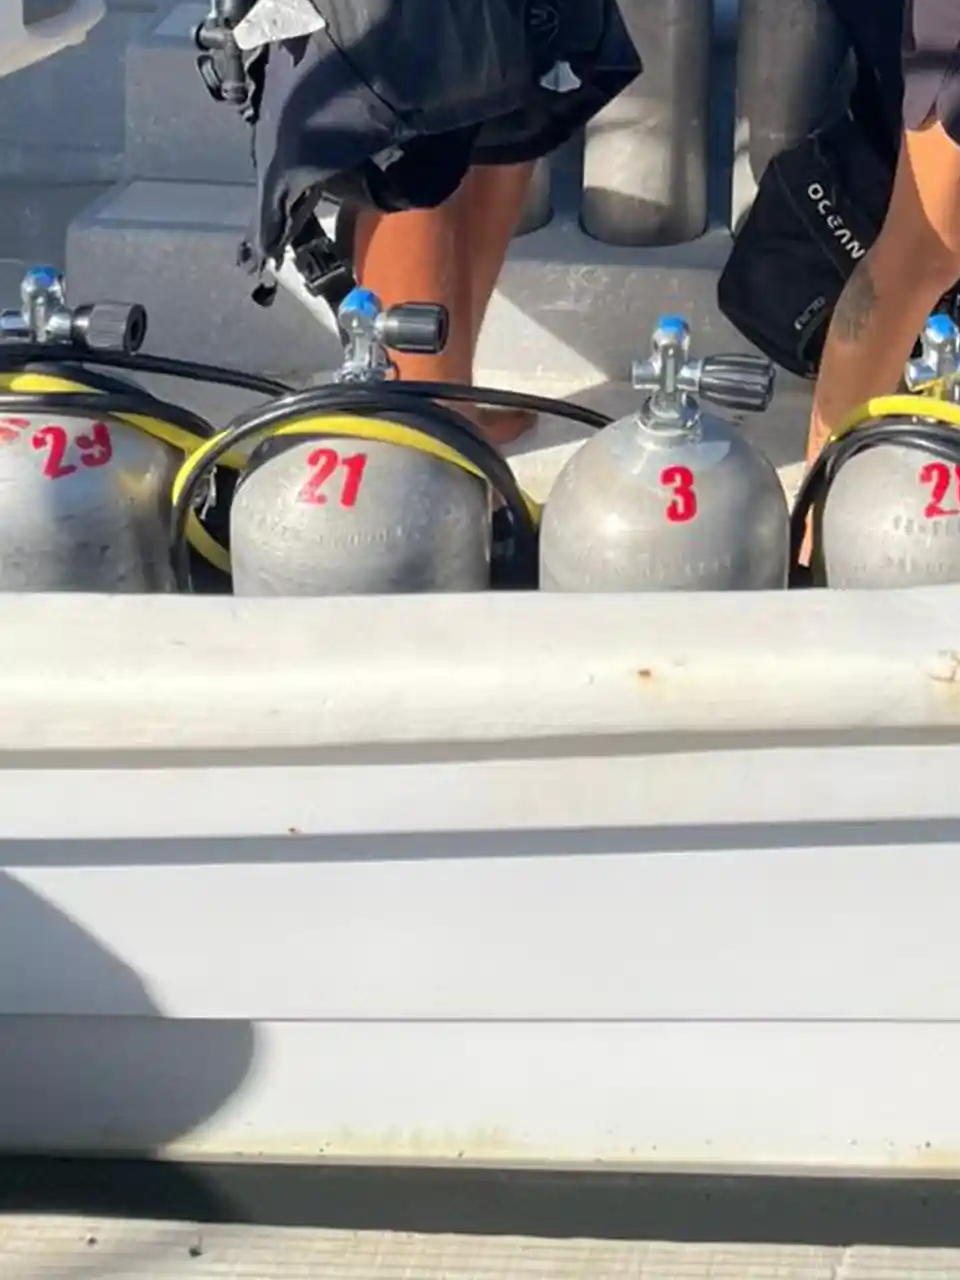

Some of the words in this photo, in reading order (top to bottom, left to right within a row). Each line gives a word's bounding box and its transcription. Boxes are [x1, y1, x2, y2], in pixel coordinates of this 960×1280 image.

[807, 182, 866, 260] OCEAN
[299, 447, 367, 508] 21
[660, 465, 698, 523] 3
